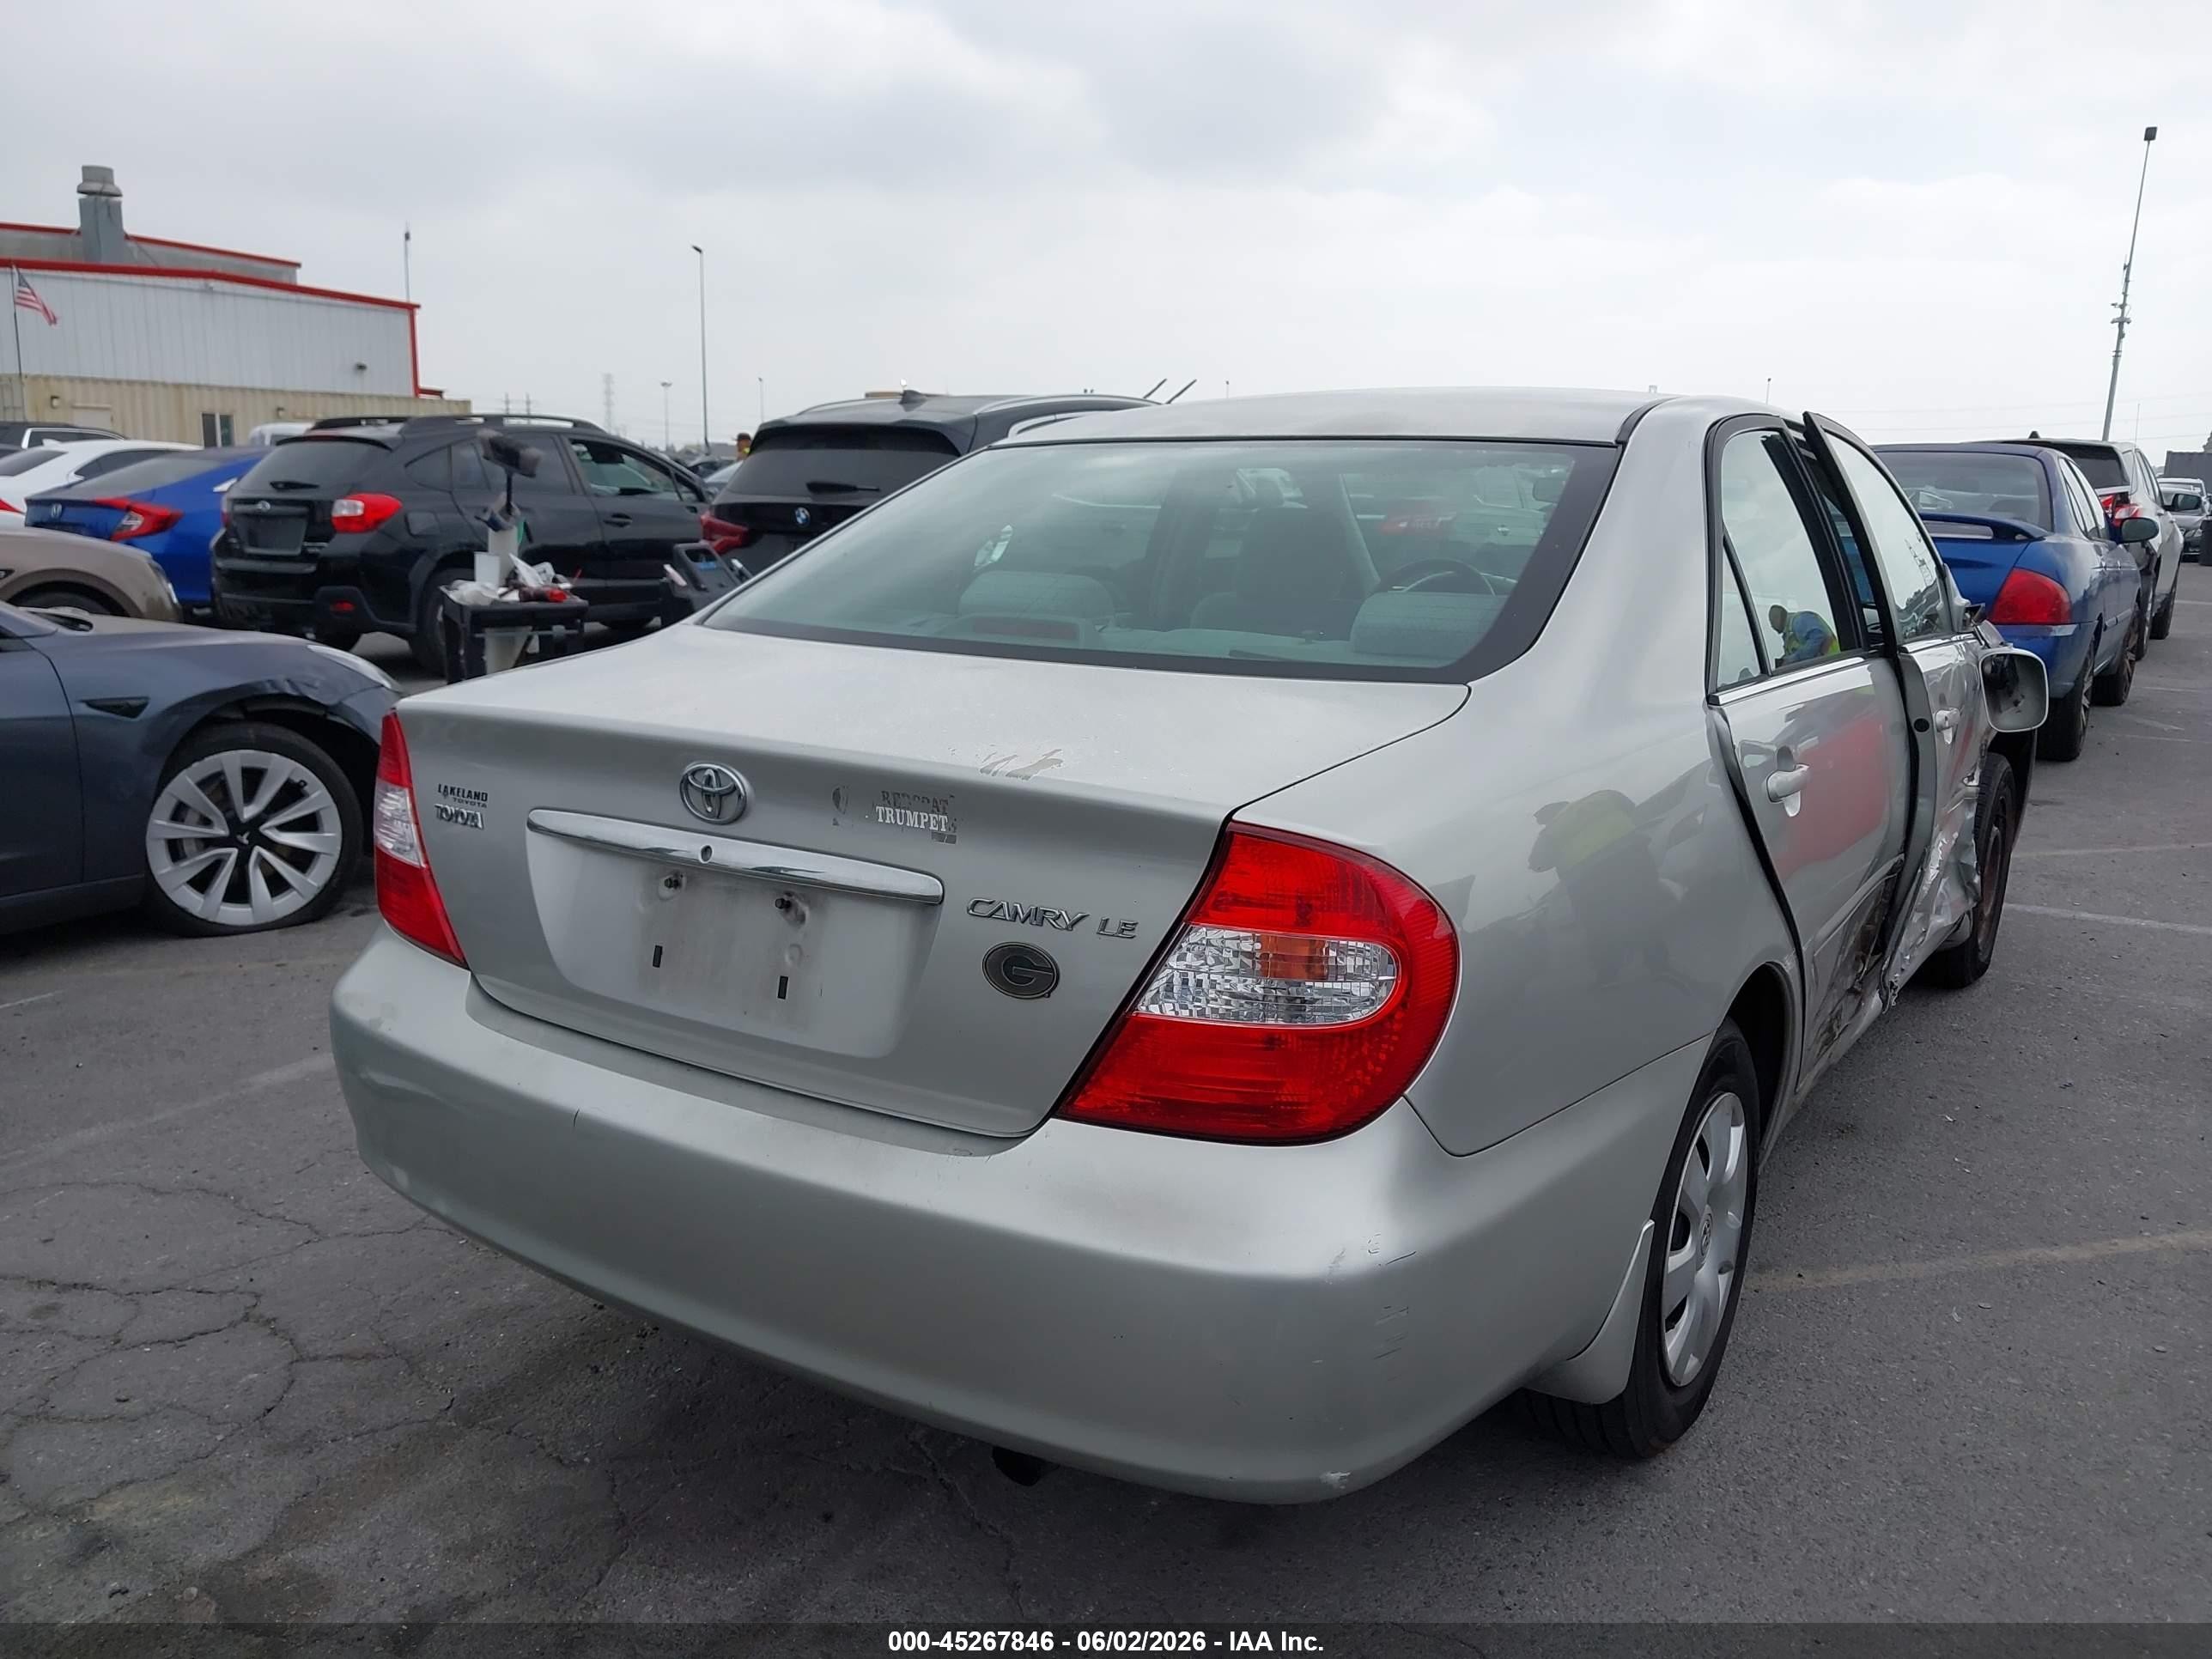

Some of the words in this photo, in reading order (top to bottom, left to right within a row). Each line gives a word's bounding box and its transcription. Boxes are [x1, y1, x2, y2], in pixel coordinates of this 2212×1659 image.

[438, 783, 488, 802] LAKELAND
[453, 797, 487, 808] TOYOTA
[875, 805, 949, 832] TRUMPET
[967, 897, 1090, 931] CAMRY
[1096, 916, 1139, 939] LE
